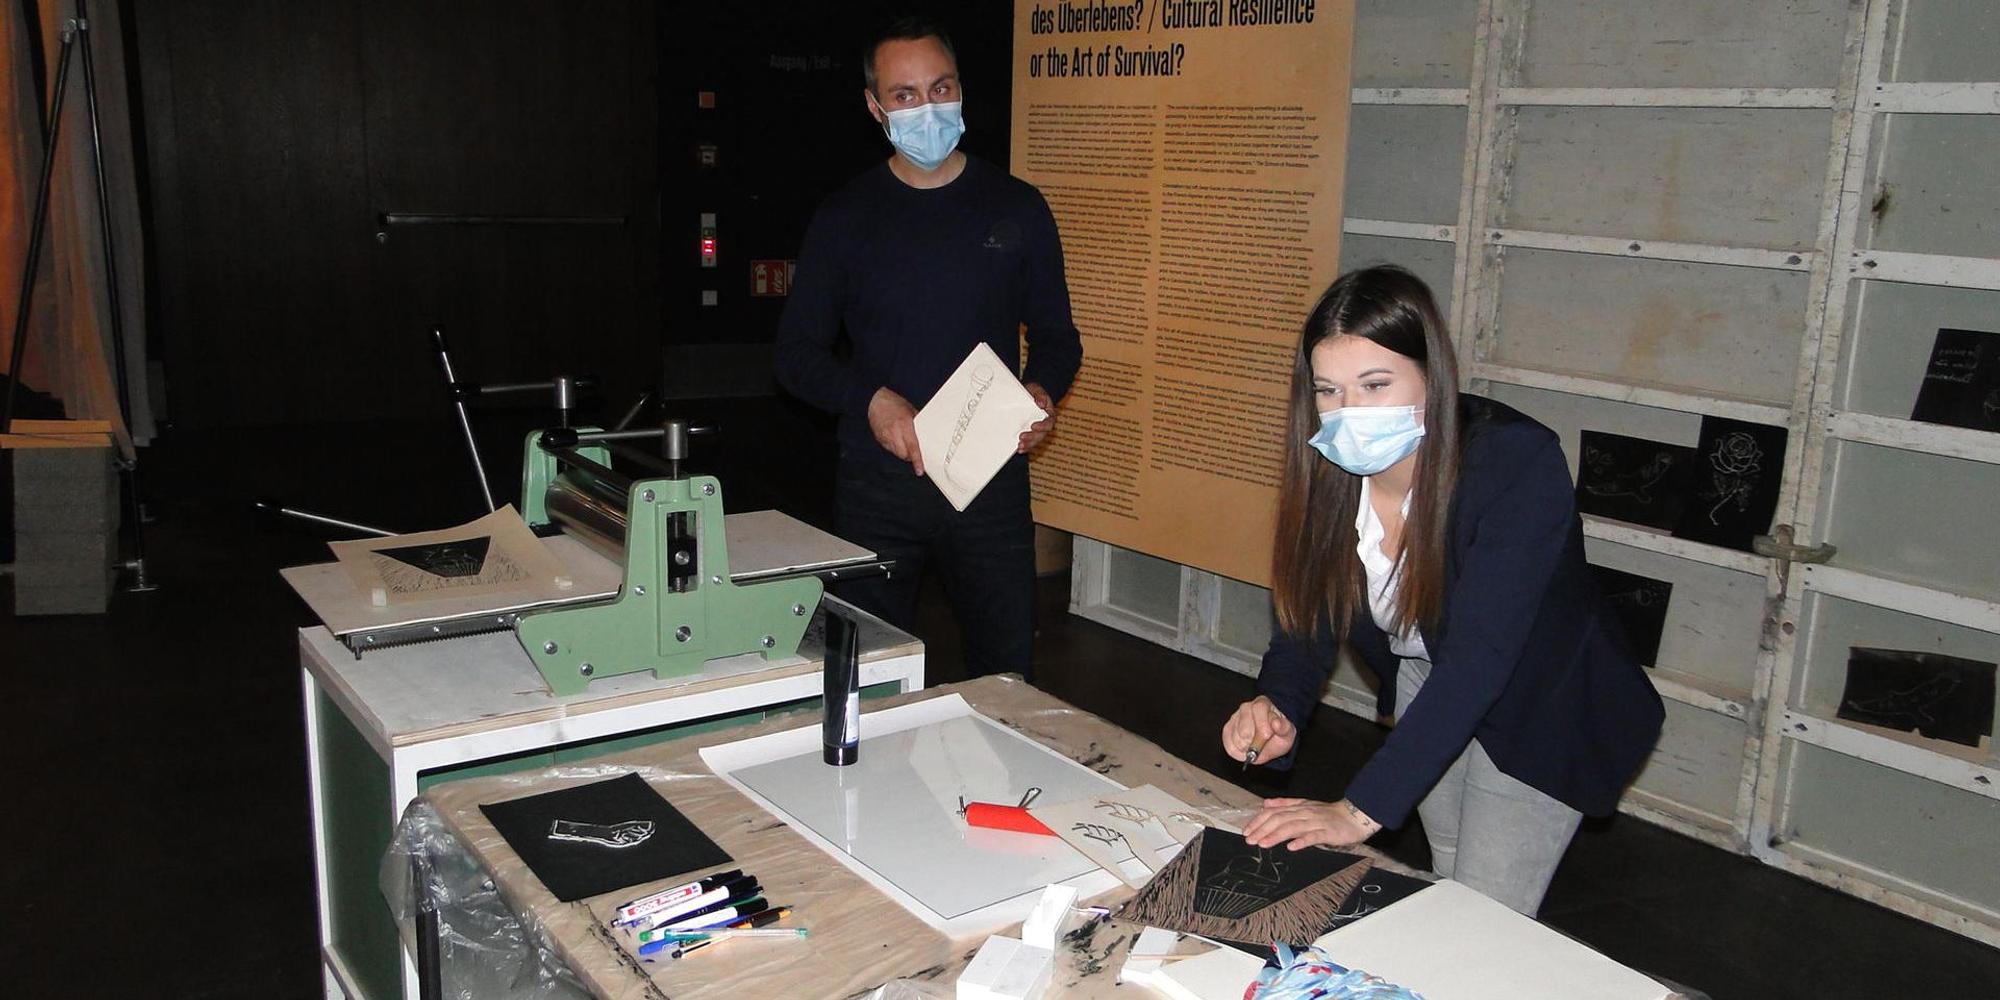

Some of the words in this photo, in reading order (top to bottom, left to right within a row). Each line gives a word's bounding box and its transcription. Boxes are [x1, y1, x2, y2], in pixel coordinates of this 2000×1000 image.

[1031, 3, 1054, 35] des
[1162, 0, 1223, 29] Cultural
[1228, 0, 1315, 26] Resilience
[1030, 54, 1044, 77] or
[1047, 47, 1068, 77] the
[1071, 47, 1093, 77] Art
[1096, 45, 1111, 77] of
[1114, 43, 1185, 76] Survival?
